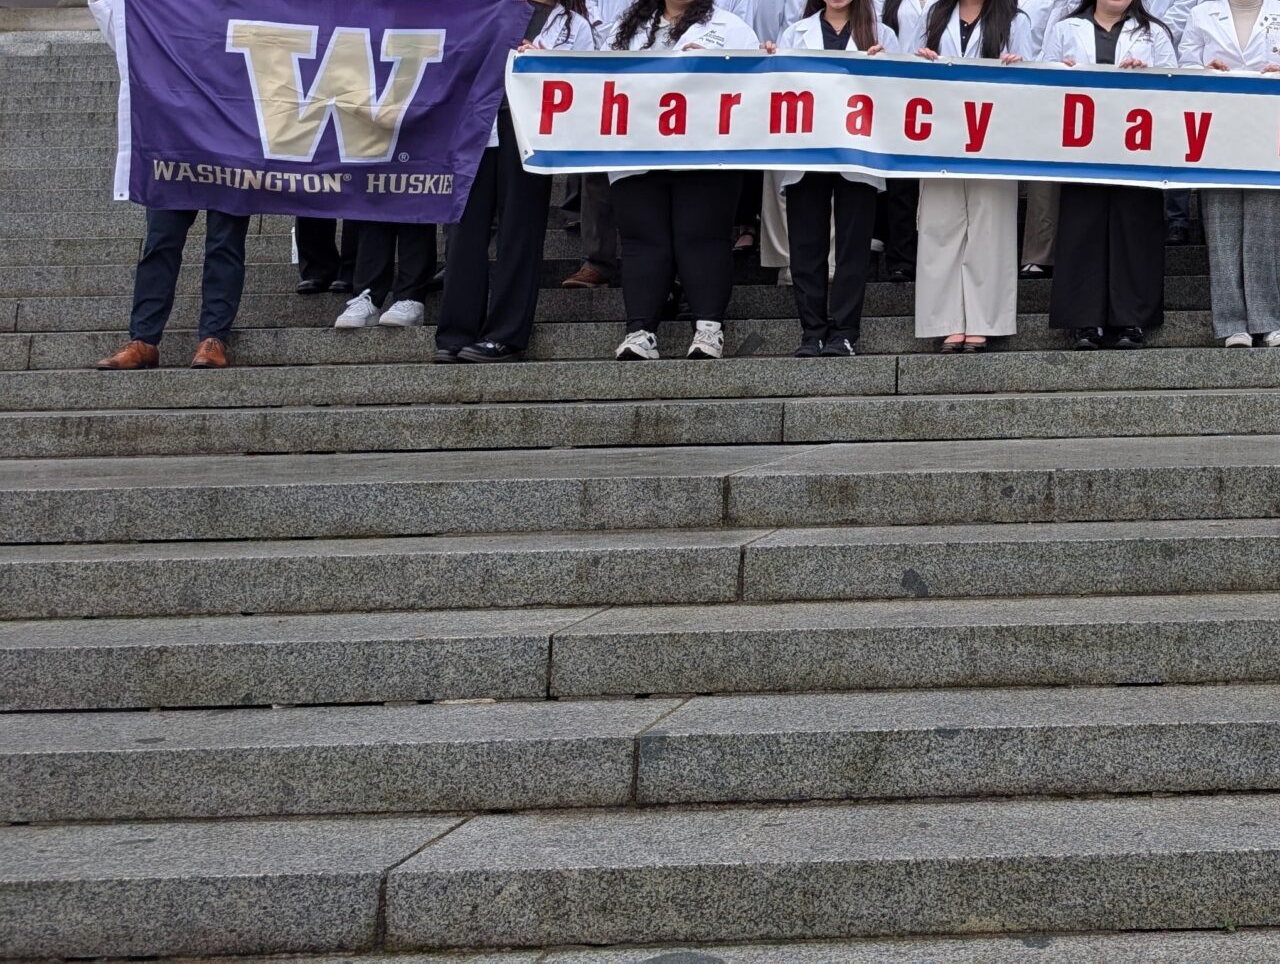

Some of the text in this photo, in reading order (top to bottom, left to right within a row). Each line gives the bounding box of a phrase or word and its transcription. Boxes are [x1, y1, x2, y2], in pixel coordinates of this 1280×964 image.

[539, 80, 993, 153] Pharmacy
[1062, 93, 1212, 162] Day
[366, 173, 454, 195] HUSKIE
